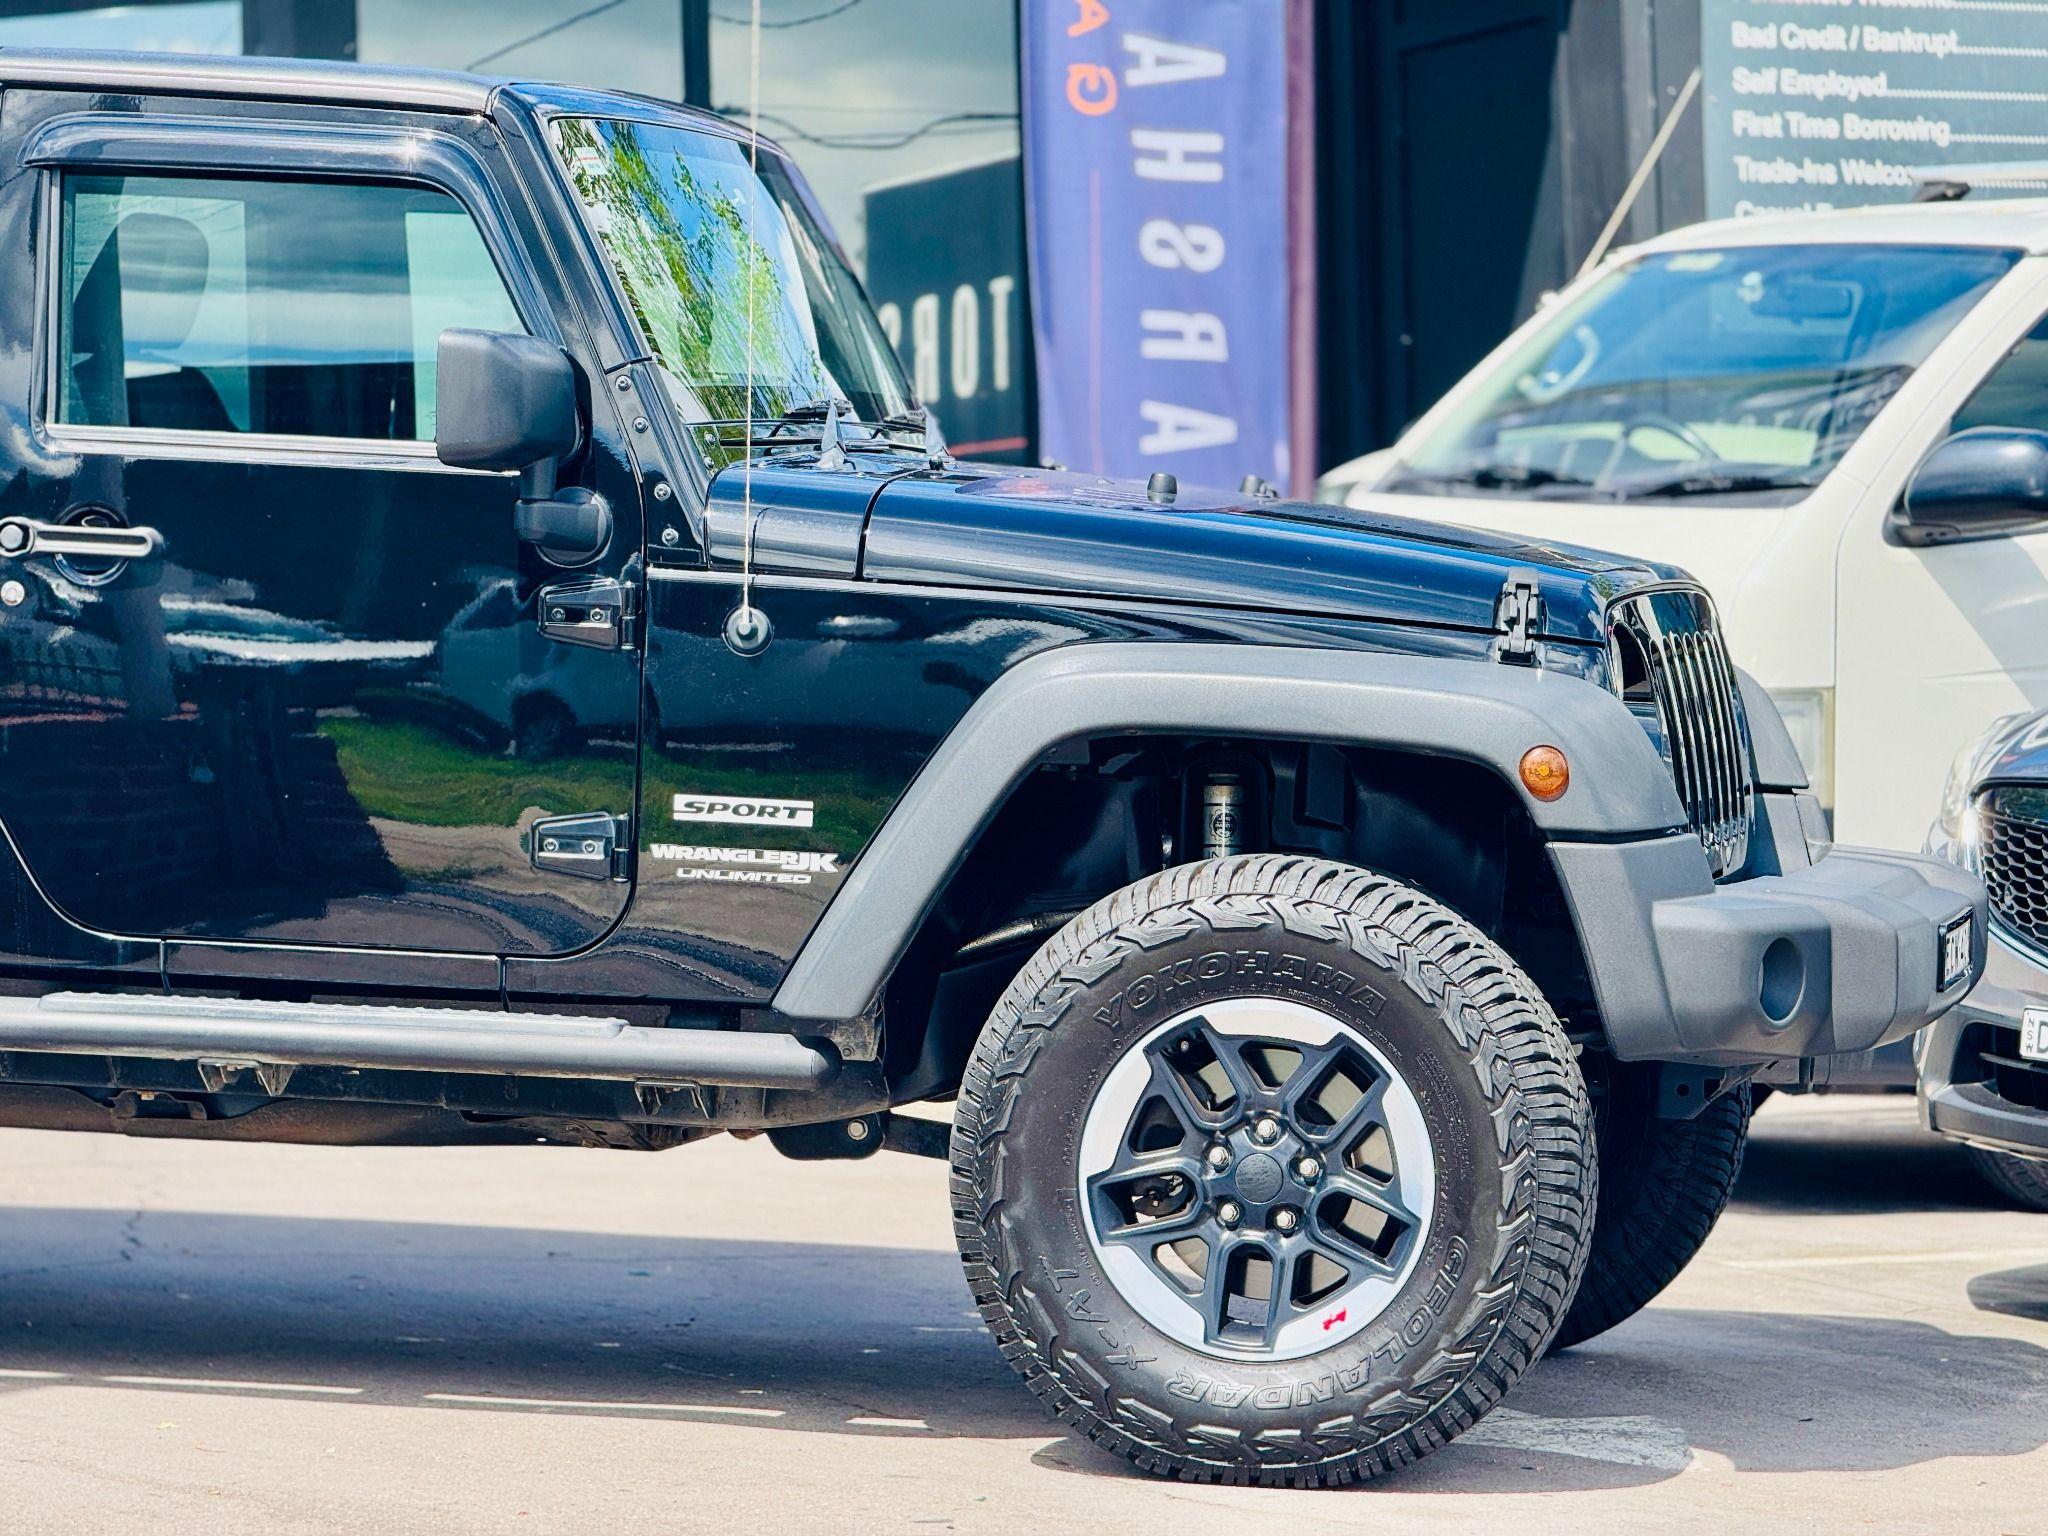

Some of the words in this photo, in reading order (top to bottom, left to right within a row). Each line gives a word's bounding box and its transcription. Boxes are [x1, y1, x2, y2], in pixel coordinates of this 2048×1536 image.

[1731, 21, 1777, 49] Bad
[1780, 23, 1847, 51] Credit
[1848, 25, 1861, 51] /
[1863, 25, 1959, 58] Bankrupt
[1732, 67, 1778, 95] Self
[1780, 68, 1888, 102] Employed
[1732, 110, 1783, 138] First
[1785, 111, 1840, 140] Time
[1843, 113, 1951, 148] Borrowing
[1733, 155, 1838, 185] Trade-Ins
[1840, 158, 1915, 186] Welco
[682, 800, 812, 820] SPORT
[676, 867, 812, 885] UNLIMITED
[1092, 949, 1388, 1030] YOKOHAMA
[2025, 1016, 2035, 1054] NSW
[1166, 1235, 1470, 1410] GEOLANDAR
